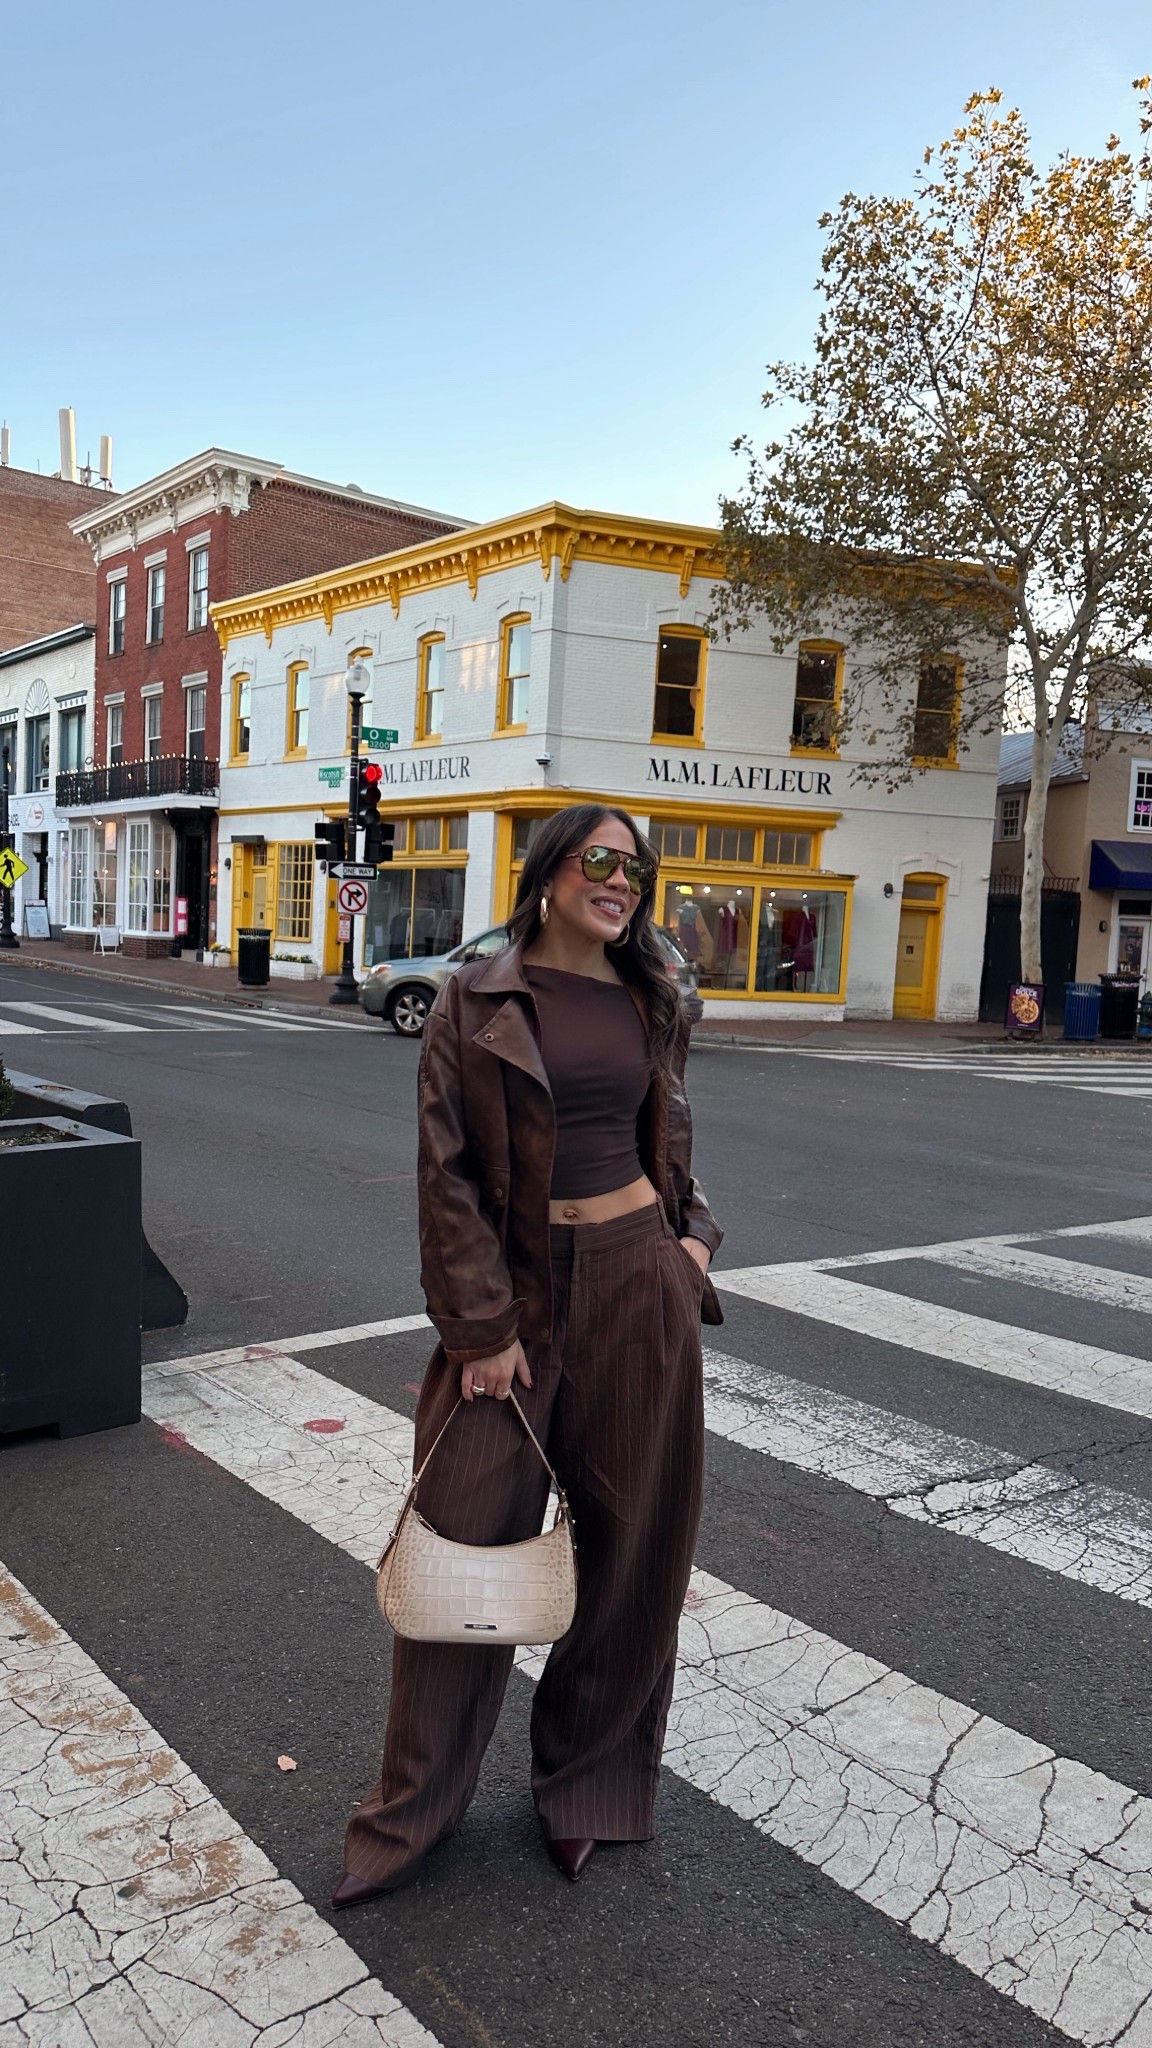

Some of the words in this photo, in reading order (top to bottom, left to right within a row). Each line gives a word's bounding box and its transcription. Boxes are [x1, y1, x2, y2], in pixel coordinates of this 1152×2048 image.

[369, 729, 379, 740] O
[369, 740, 390, 750] 3200
[400, 756, 471, 783] LAFLEUR
[646, 757, 706, 786] M.M.
[710, 763, 832, 795] LAFLEUR
